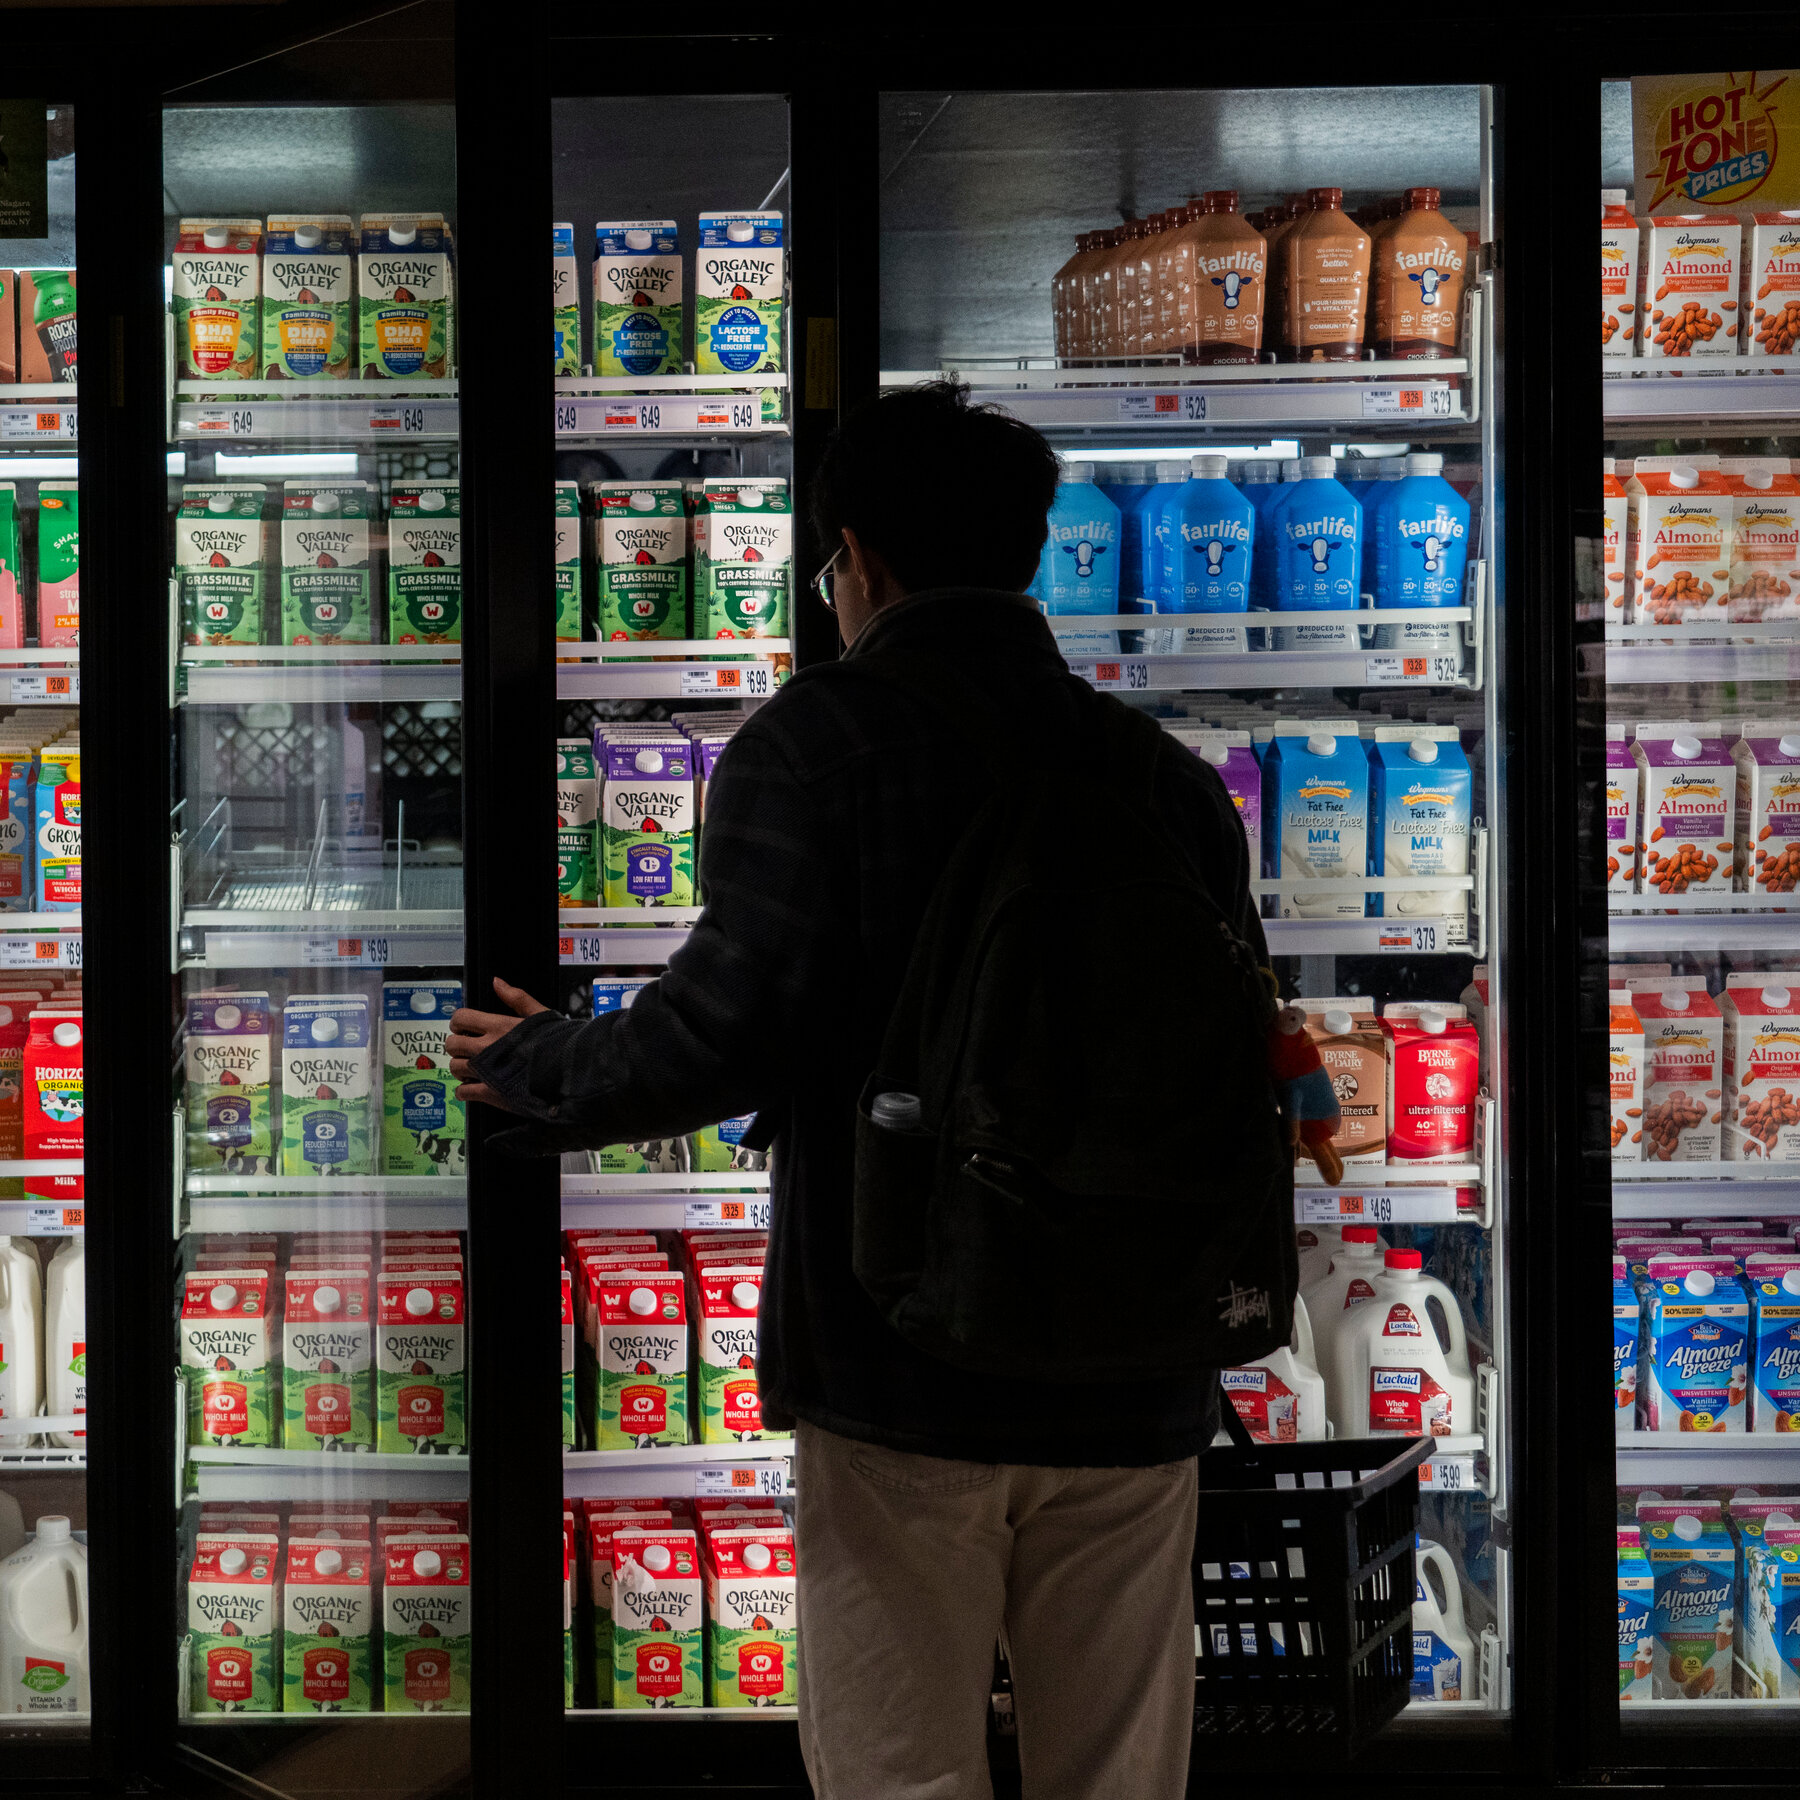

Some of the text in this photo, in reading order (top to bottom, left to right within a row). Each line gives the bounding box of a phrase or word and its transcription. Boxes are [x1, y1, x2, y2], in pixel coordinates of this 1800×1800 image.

[1671, 88, 1746, 142] HOT
[1660, 115, 1768, 187] ZONE
[1691, 153, 1765, 197] PRICES
[1676, 233, 1720, 248] Wegmans
[181, 260, 249, 277] ORGANIC
[272, 257, 342, 277] ORGANIC
[368, 262, 437, 277] ORGANIC
[705, 259, 775, 275] ORGANIC
[1322, 258, 1349, 268] better
[1662, 260, 1732, 275] Almond
[607, 267, 674, 282] ORGANIC
[278, 272, 337, 291] VALLEY
[406, 310, 425, 318] First
[195, 325, 234, 337] DHA
[384, 326, 423, 337] DHA
[621, 332, 661, 340] LACTOSE
[719, 327, 760, 335] LACTOSE
[727, 335, 751, 343] FREE
[1213, 357, 1247, 365] CHOCOLATE
[1668, 503, 1712, 518] Wegmans
[1745, 504, 1787, 518] Wegmans
[191, 530, 247, 544] ORGANIC
[296, 531, 353, 544] ORGANIC
[729, 536, 775, 547] VALLEY
[1654, 530, 1723, 544] Almond
[1732, 530, 1799, 543] Almond
[195, 541, 242, 553] VALLEY
[301, 541, 349, 553] VALLEY
[186, 576, 251, 586] GRASSMILK
[293, 576, 359, 586] GRASSMILK
[612, 572, 677, 583] GRASSMILK
[718, 571, 785, 581] GRASSMILK
[211, 606, 223, 617] W
[320, 607, 332, 617] W
[638, 603, 649, 614] W
[745, 602, 757, 611] W
[1305, 776, 1346, 789] Wegmans
[1671, 774, 1715, 788] Wegmans
[1408, 782, 1448, 796] Wegmans
[615, 792, 684, 808] ORGANIC
[1307, 801, 1343, 812] Fat Free
[621, 805, 678, 818] VALLEY
[1410, 808, 1446, 818] Fat Free
[1657, 800, 1727, 814] Almond
[1288, 812, 1362, 827] Lactose Free
[1392, 820, 1465, 834] Lactose Free
[1662, 1025, 1703, 1039] Wegmans
[1324, 1050, 1357, 1063] BYRNE
[1334, 1058, 1363, 1068] DAIRY
[1418, 1050, 1451, 1063] BYRNE
[1427, 1058, 1456, 1067] DAIRY
[1650, 1050, 1715, 1064] Almond
[35, 1067, 83, 1081] HORIZO
[296, 1072, 352, 1086] VALLEY
[55, 1177, 76, 1186] Milk
[604, 1295, 621, 1305] W
[188, 1331, 256, 1346] ORGANIC
[292, 1334, 362, 1348] ORGANIC
[609, 1336, 678, 1350] ORGANIC
[195, 1344, 250, 1357] VALLEY
[299, 1347, 356, 1360] VALLEY
[392, 1349, 448, 1362] VALLEY
[615, 1348, 669, 1361] VALLEY
[1665, 1339, 1743, 1367] Almond
[1681, 1358, 1731, 1379] Breeze
[1223, 1373, 1264, 1384] Lactaid
[1376, 1372, 1418, 1385] Lactaid
[1232, 1400, 1255, 1408] Whole
[1386, 1400, 1408, 1408] Whole
[205, 1413, 246, 1422] WHOLE MILK
[426, 1415, 442, 1423] MILK
[648, 1414, 664, 1422] MILK
[717, 1551, 733, 1562] W
[196, 1595, 264, 1610] ORGANIC
[624, 1591, 692, 1606] ORGANIC
[726, 1589, 794, 1605] ORGANIC
[1655, 1584, 1730, 1610] Almond
[292, 1596, 362, 1612] ORGANIC
[392, 1597, 462, 1613] ORGANIC
[630, 1603, 687, 1617] VALLEY
[732, 1602, 788, 1616] VALLEY
[202, 1607, 255, 1622] VALLEY
[299, 1610, 355, 1624] VALLEY
[399, 1610, 456, 1624] VALLEY
[1670, 1603, 1718, 1622] Breeze
[1677, 1644, 1707, 1652] Original
[28, 1676, 60, 1690] Organic
[306, 1679, 347, 1688] WHOLE MILK
[639, 1675, 662, 1683] WHOLE
[766, 1674, 781, 1682] MILK
